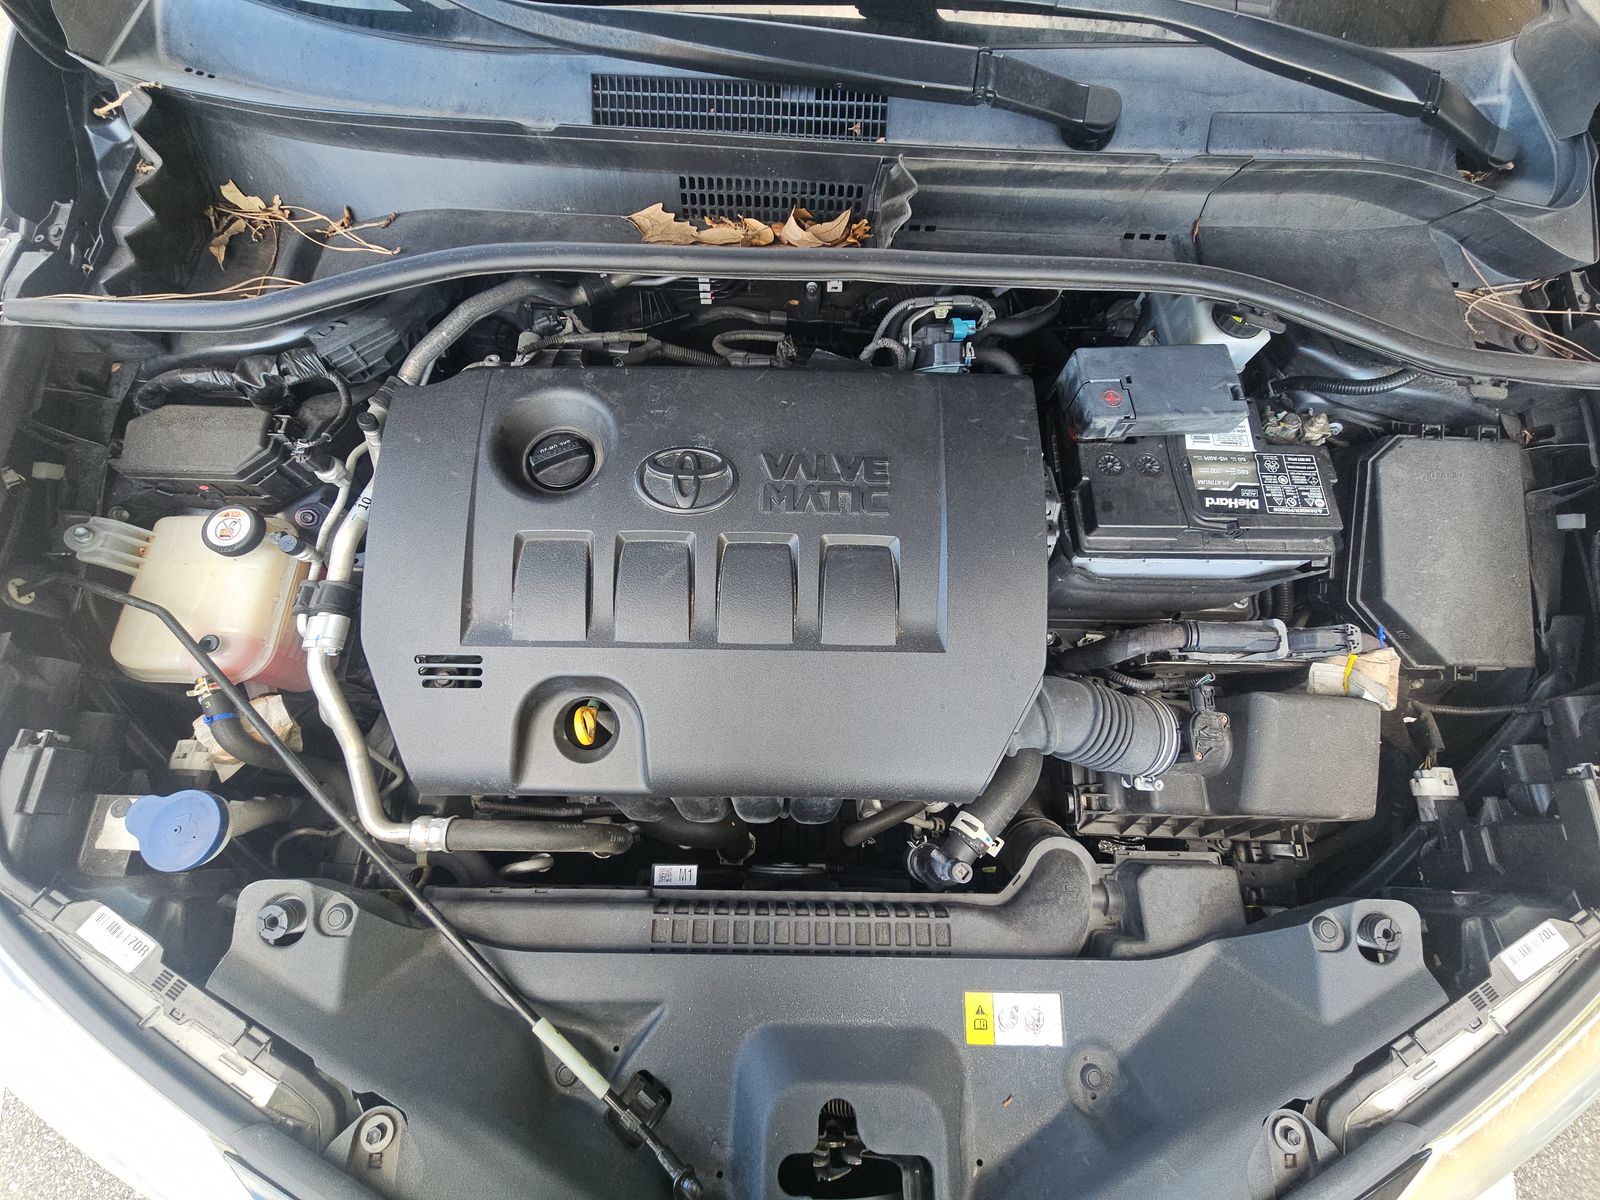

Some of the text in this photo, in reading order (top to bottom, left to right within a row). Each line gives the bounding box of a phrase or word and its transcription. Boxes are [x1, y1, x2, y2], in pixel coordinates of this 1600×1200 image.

[760, 453, 890, 484] VALVE
[760, 484, 890, 516] MATIC
[1205, 497, 1260, 510] DieHard
[678, 867, 692, 881] M1
